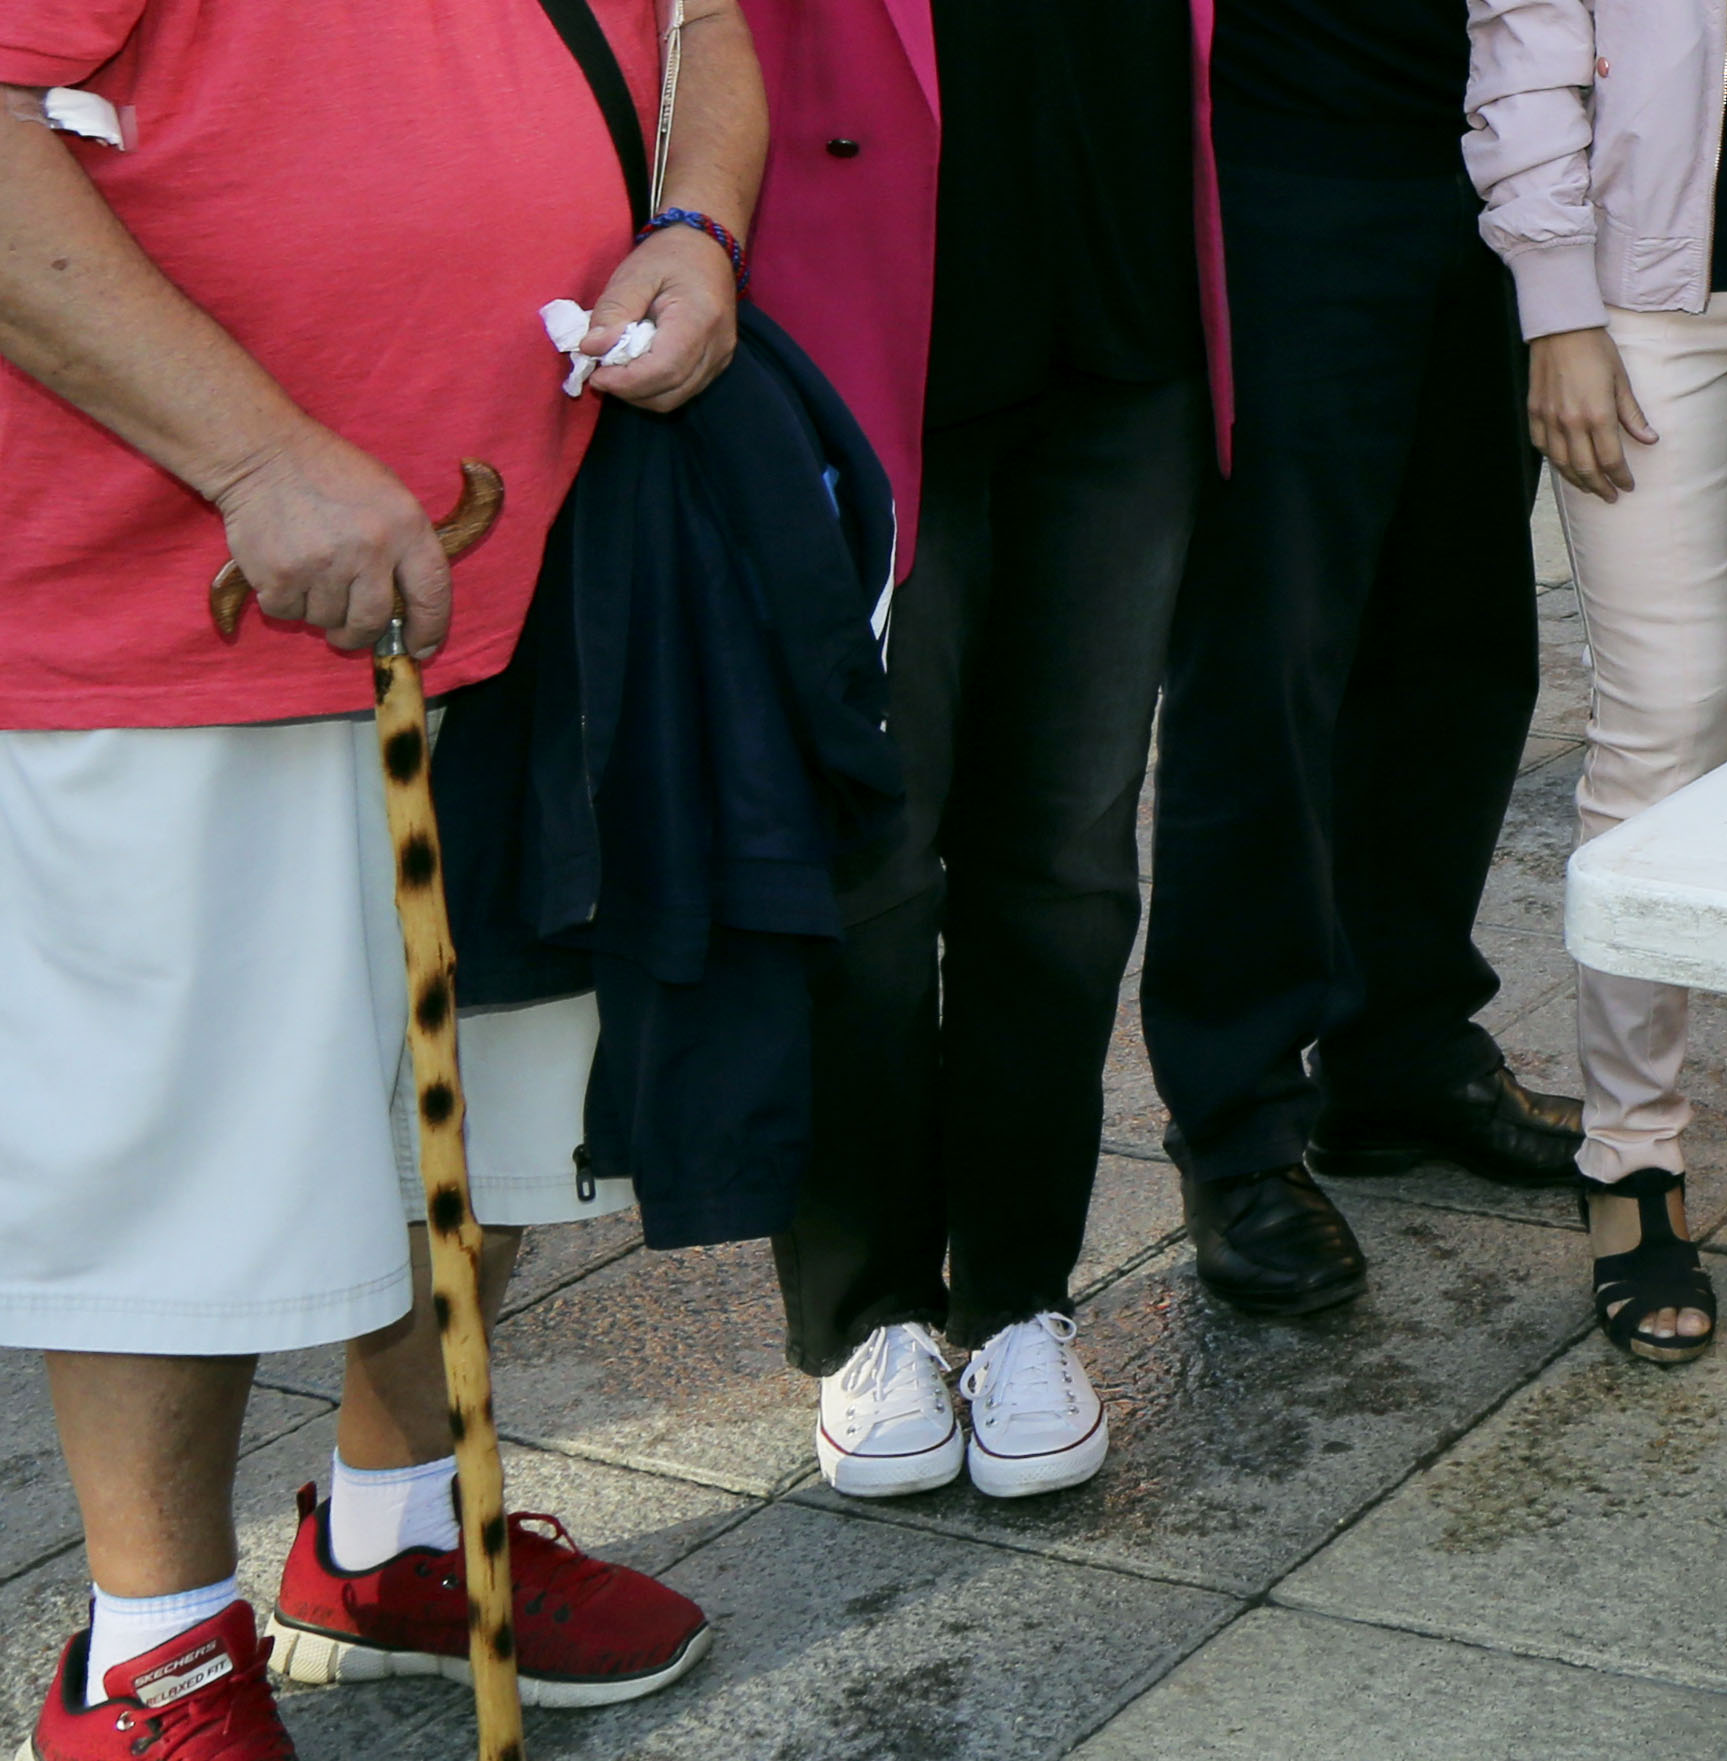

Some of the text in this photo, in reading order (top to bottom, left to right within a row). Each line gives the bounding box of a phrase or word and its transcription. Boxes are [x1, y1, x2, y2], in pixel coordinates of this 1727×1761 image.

[134, 1639, 217, 1690] SKECHERS
[145, 1658, 227, 1706] RELAXED FIT
